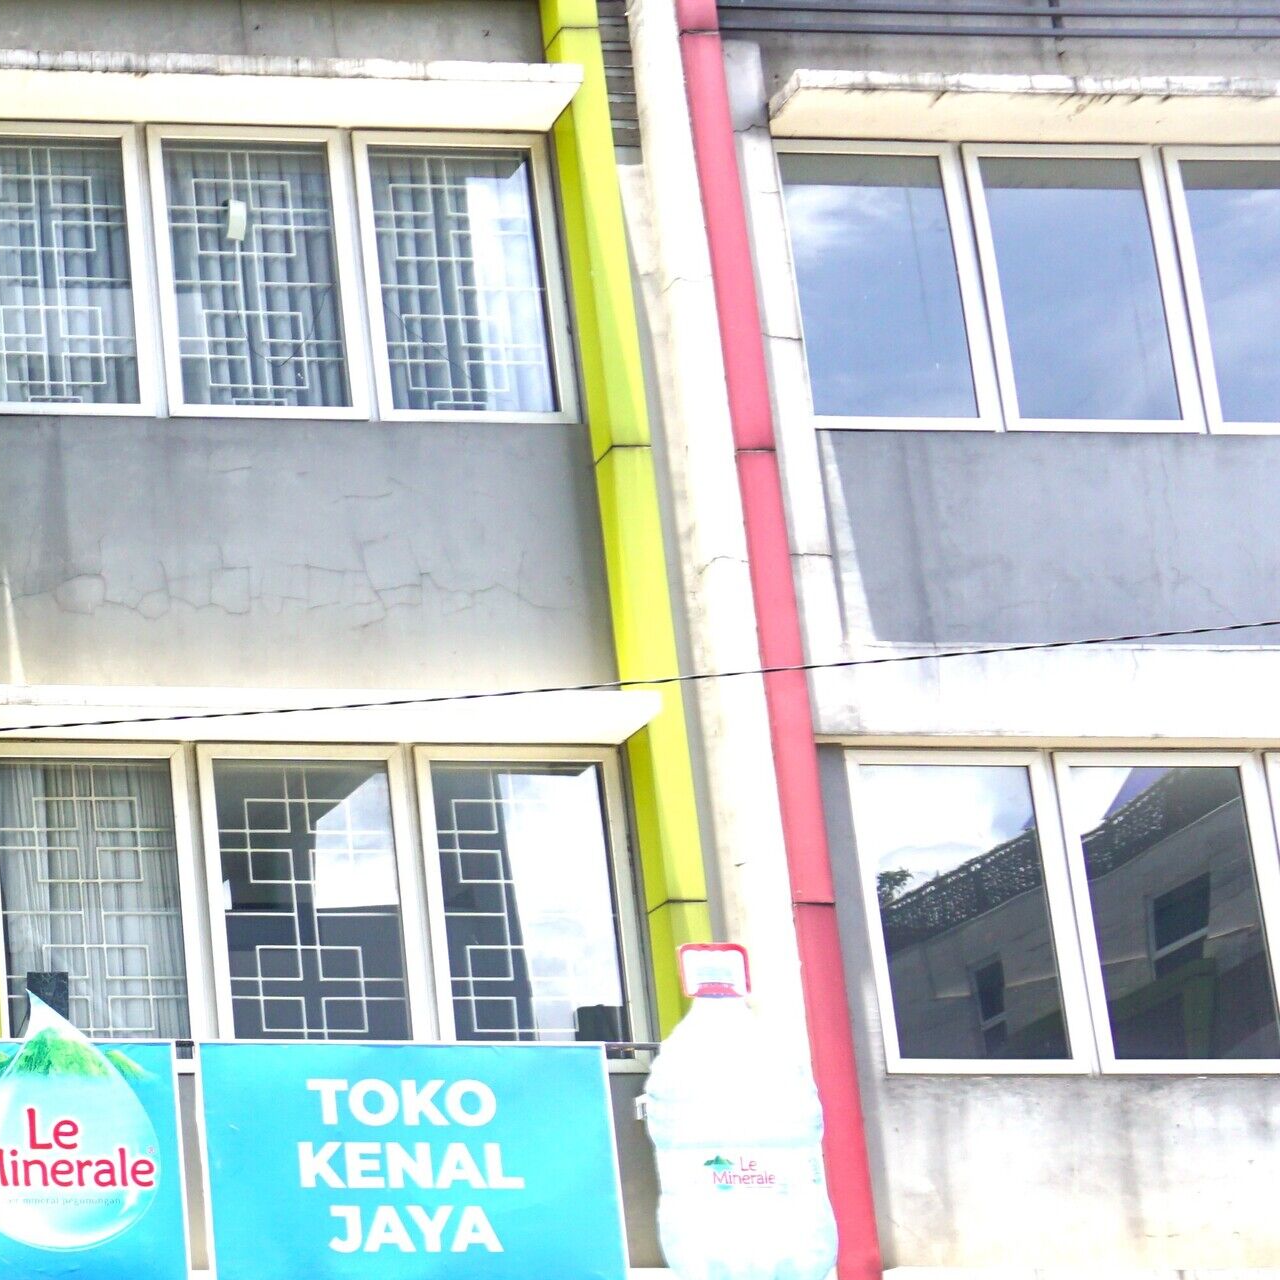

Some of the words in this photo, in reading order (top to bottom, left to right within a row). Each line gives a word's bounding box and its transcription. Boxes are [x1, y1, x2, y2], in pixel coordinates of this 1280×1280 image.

[306, 1078, 497, 1128] TOKO
[26, 1108, 80, 1150] Le
[296, 1141, 527, 1190] KENAL
[712, 1171, 776, 1185] Minerale
[739, 1156, 758, 1172] Le
[328, 1204, 505, 1254] JAYA
